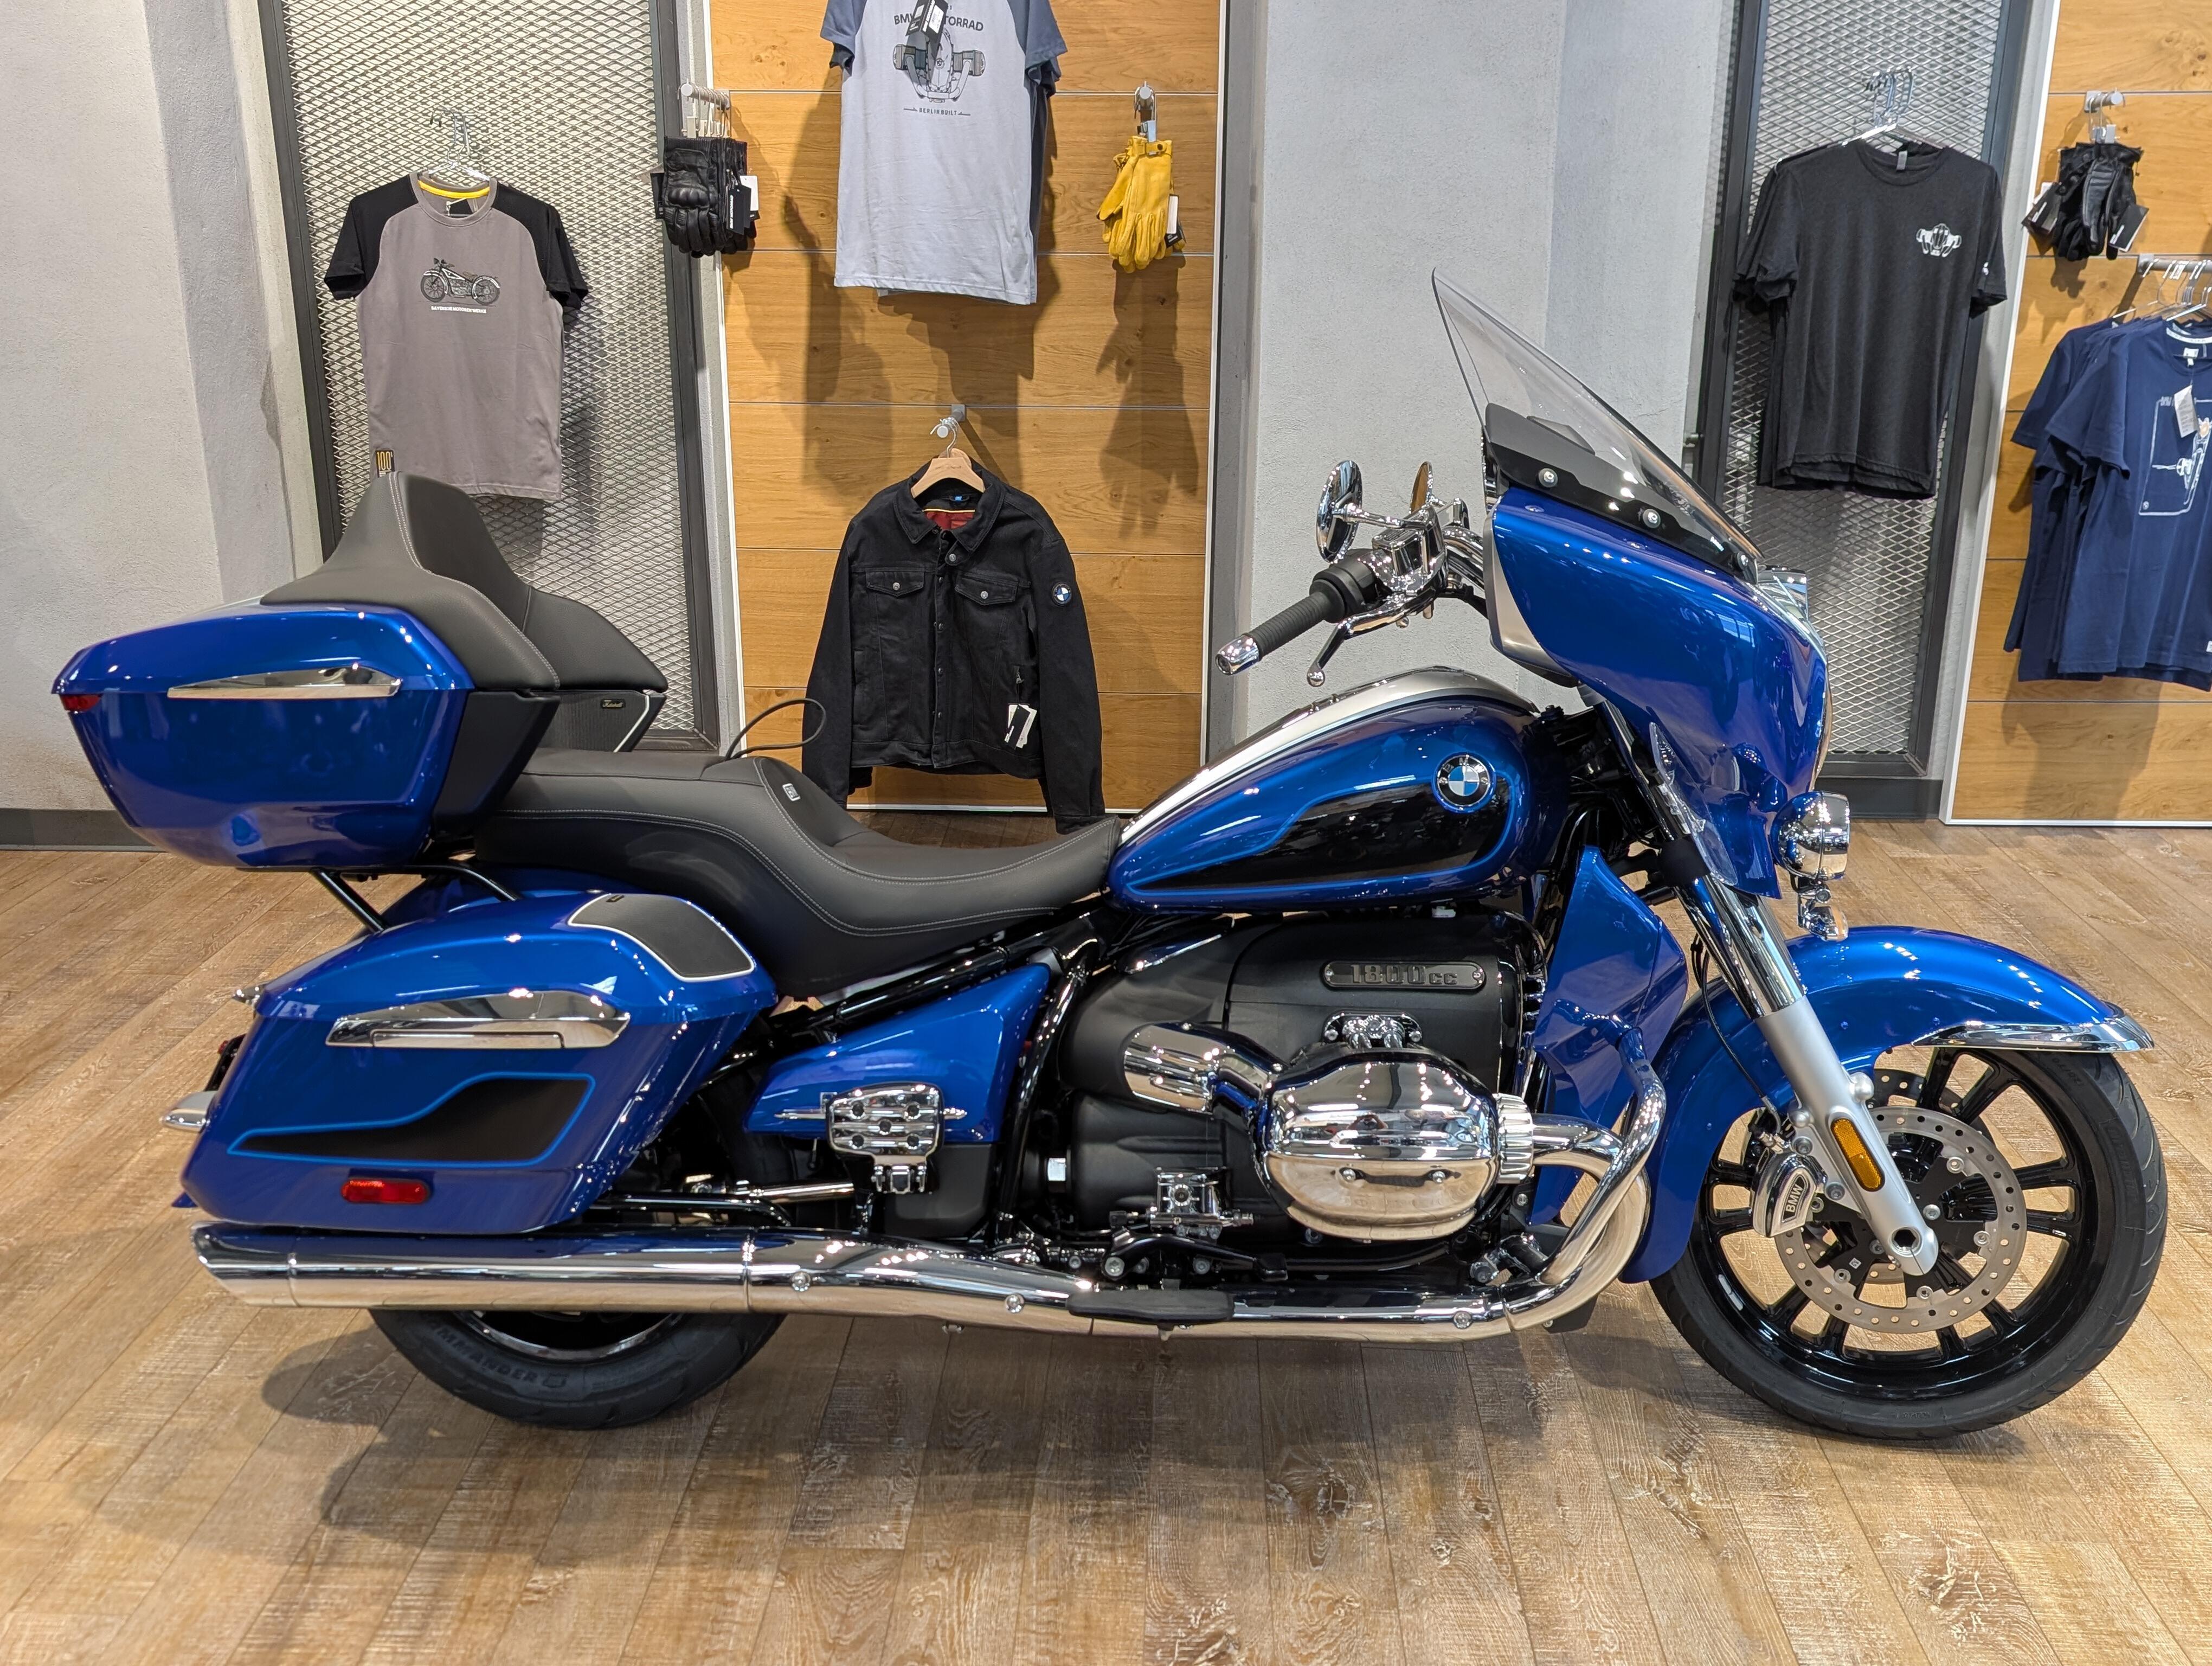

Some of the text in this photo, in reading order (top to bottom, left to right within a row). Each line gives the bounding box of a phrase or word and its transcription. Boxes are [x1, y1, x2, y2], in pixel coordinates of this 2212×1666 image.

[943, 16, 984, 31] TORRAD
[376, 451, 392, 471] 100
[1442, 757, 1486, 773] BMW
[1351, 964, 1458, 984] 1800cc
[1785, 1183, 1803, 1213] BMW
